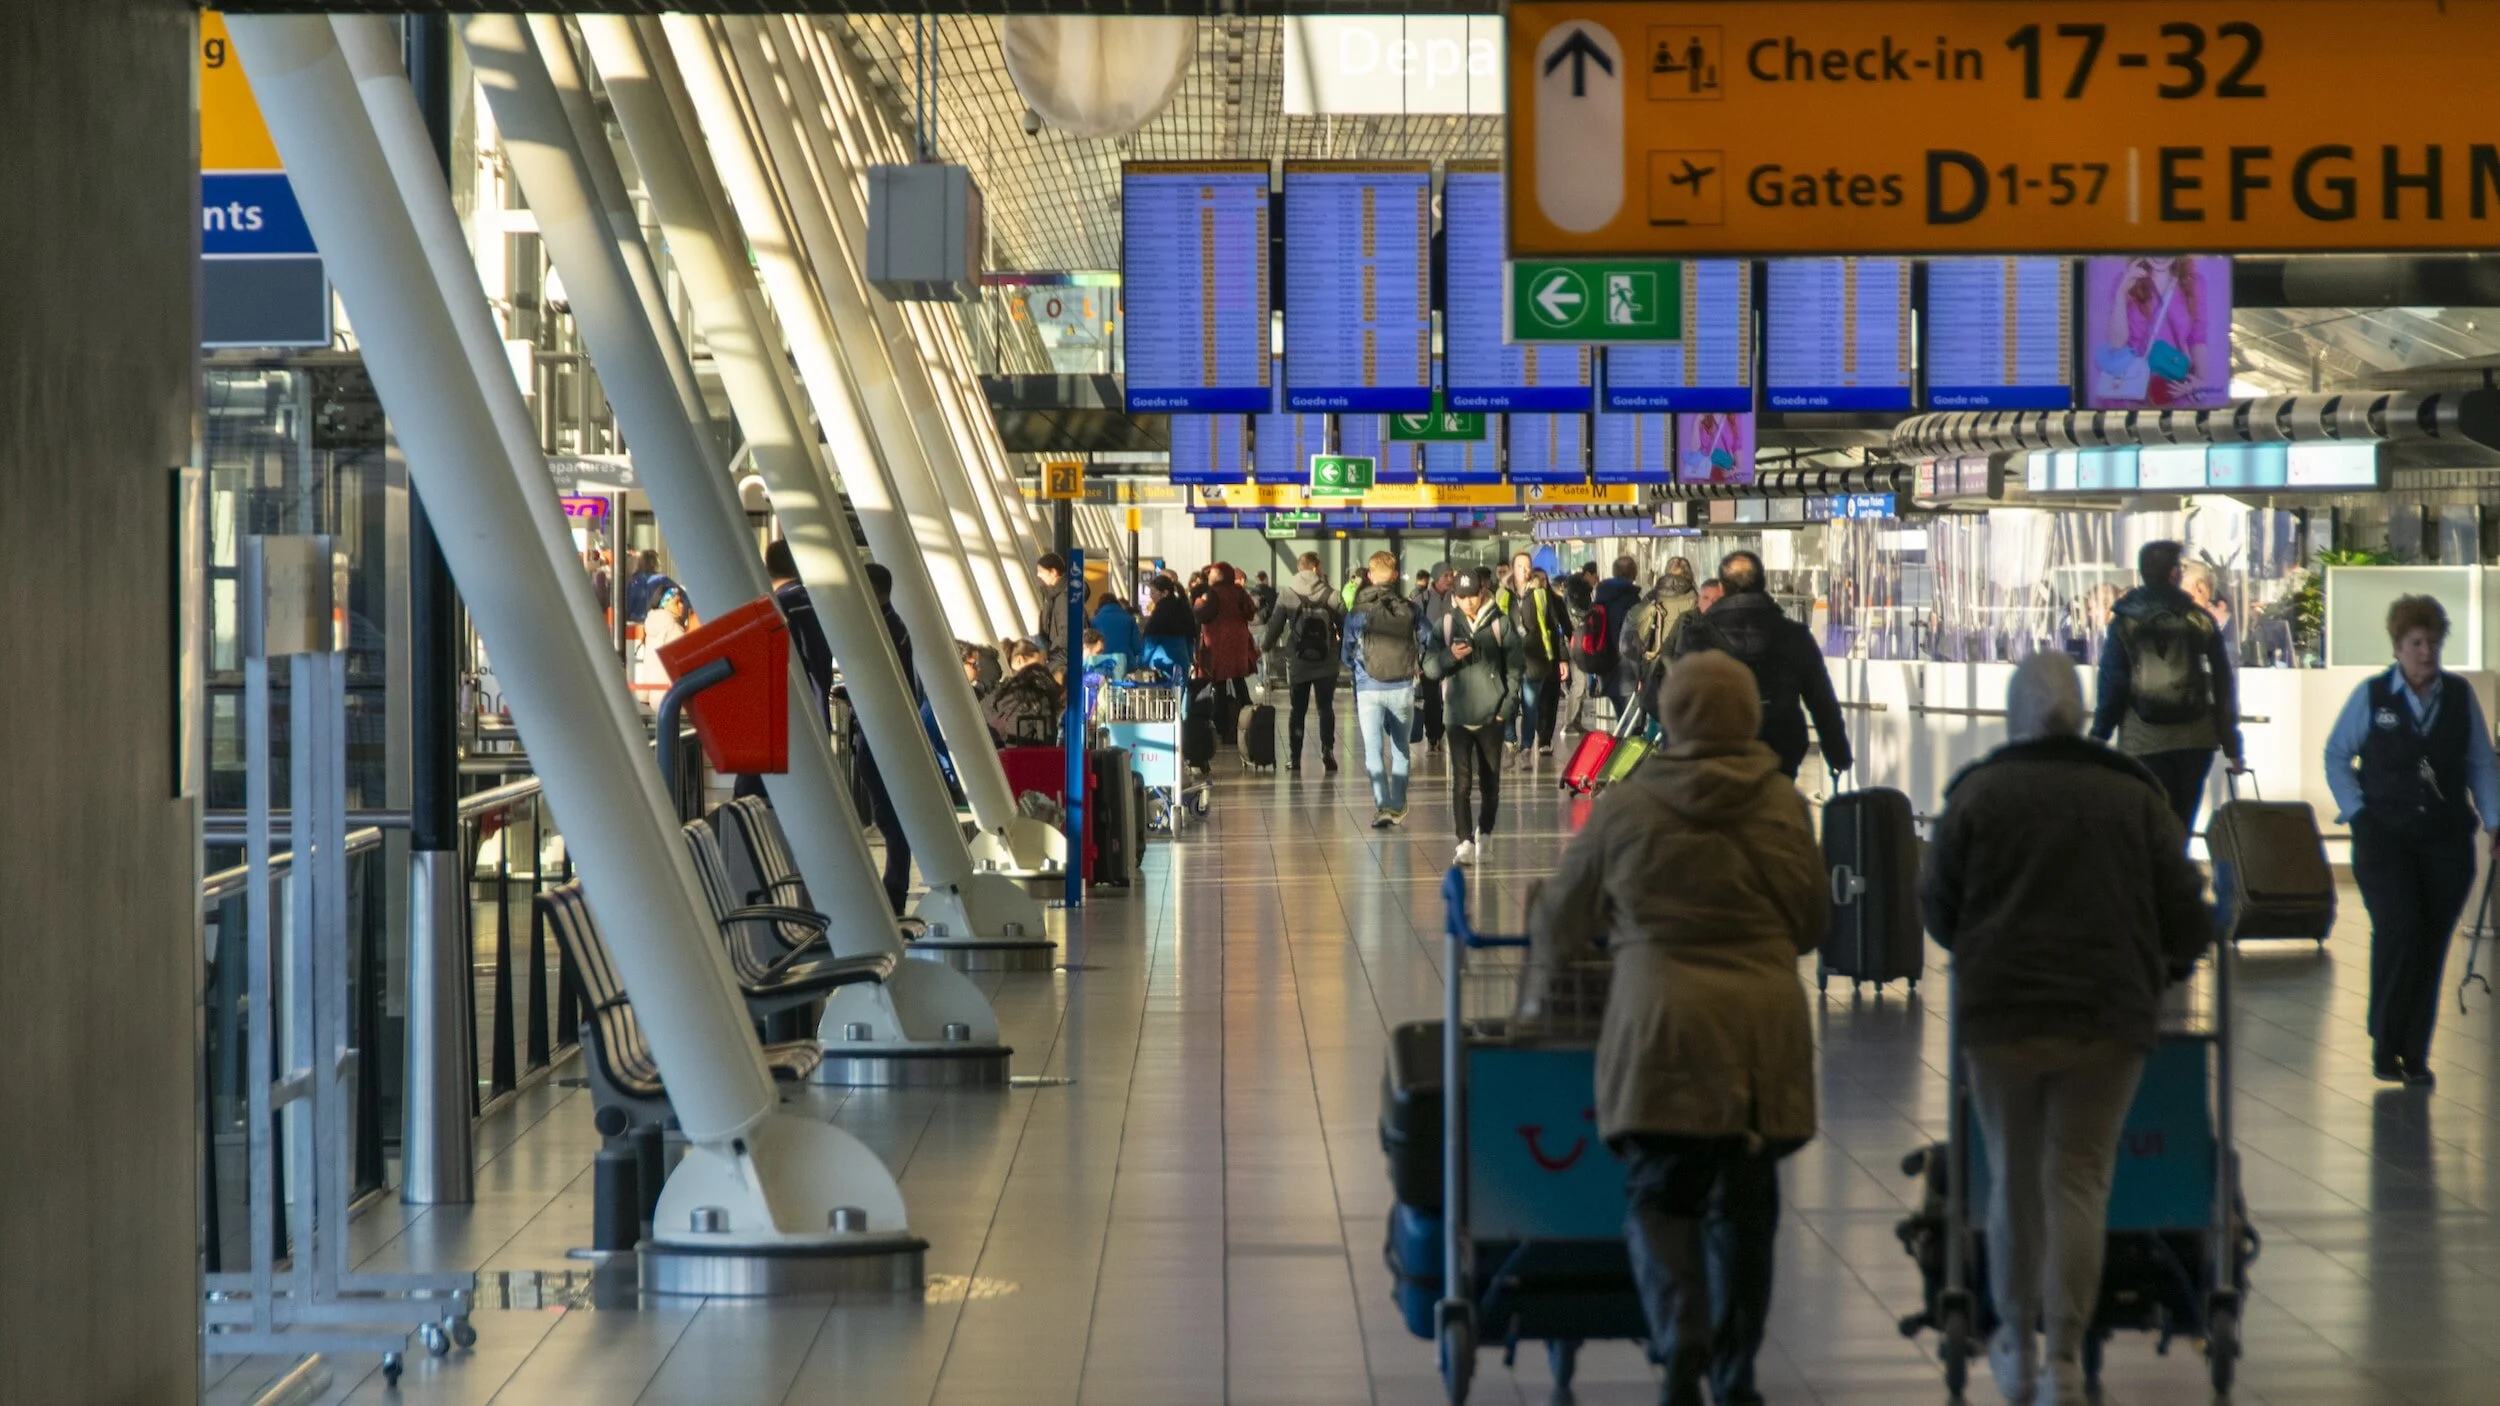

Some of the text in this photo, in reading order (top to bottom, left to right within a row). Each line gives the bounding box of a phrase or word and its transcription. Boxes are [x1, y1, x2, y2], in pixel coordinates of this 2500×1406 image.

[204, 37, 225, 69] g
[1747, 21, 2266, 99] Check-in 17-32
[1747, 163, 1904, 207] Gates
[203, 201, 264, 231] nts
[1132, 396, 1190, 407] Goede reis
[1292, 396, 1349, 407] Goede reis
[1453, 395, 1510, 406] Goede reis
[1612, 395, 1669, 406] Goede reis
[1772, 395, 1829, 405] Goede reis
[1933, 395, 1989, 405] Goede reis
[1258, 487, 1284, 497] Trains
[1563, 485, 1607, 498] Gates M
[1139, 752, 1158, 762] TUI
